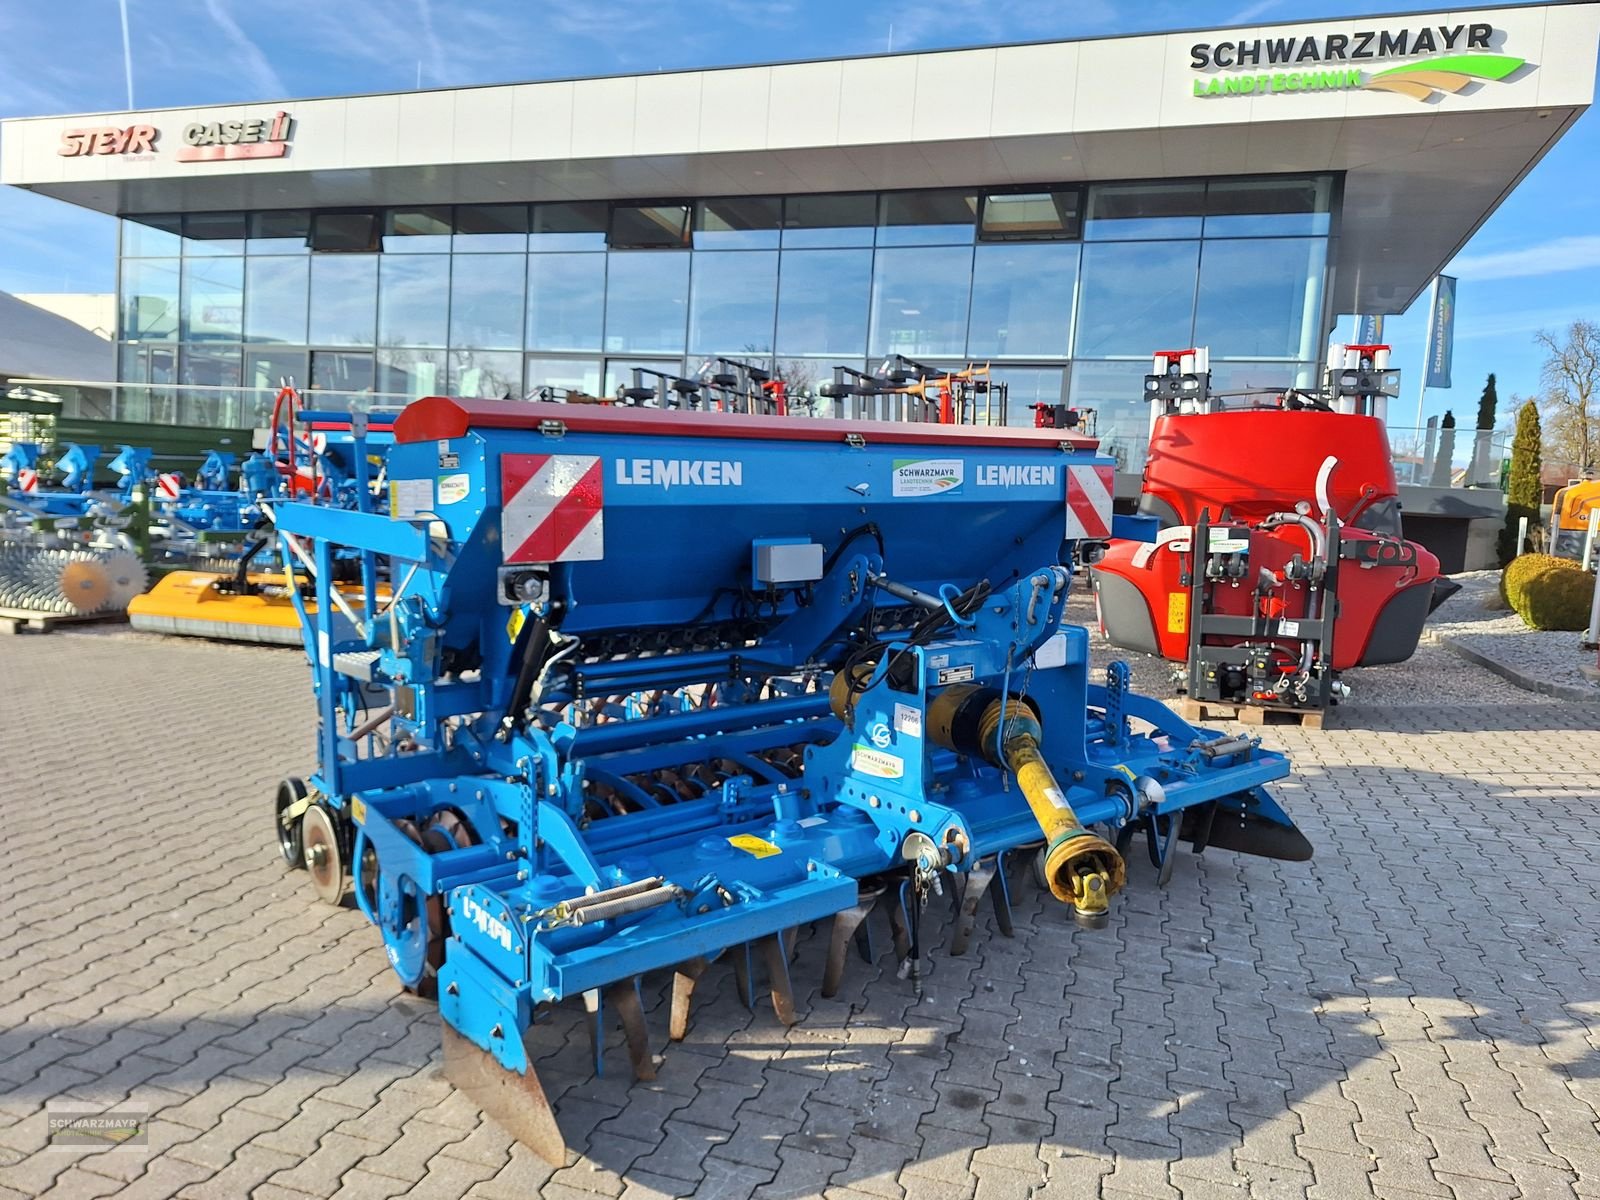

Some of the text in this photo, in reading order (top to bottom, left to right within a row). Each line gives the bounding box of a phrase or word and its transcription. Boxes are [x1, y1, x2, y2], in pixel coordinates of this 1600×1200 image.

[1190, 23, 1493, 70] SCHWARZMAYR
[1193, 69, 1362, 97] LANDTECHNIK
[57, 124, 158, 157] STEYR
[182, 119, 263, 146] CASE
[615, 458, 743, 491] LEMKEN
[899, 468, 955, 477] SCHWARZMAYR
[976, 465, 1055, 490] LEMKEN
